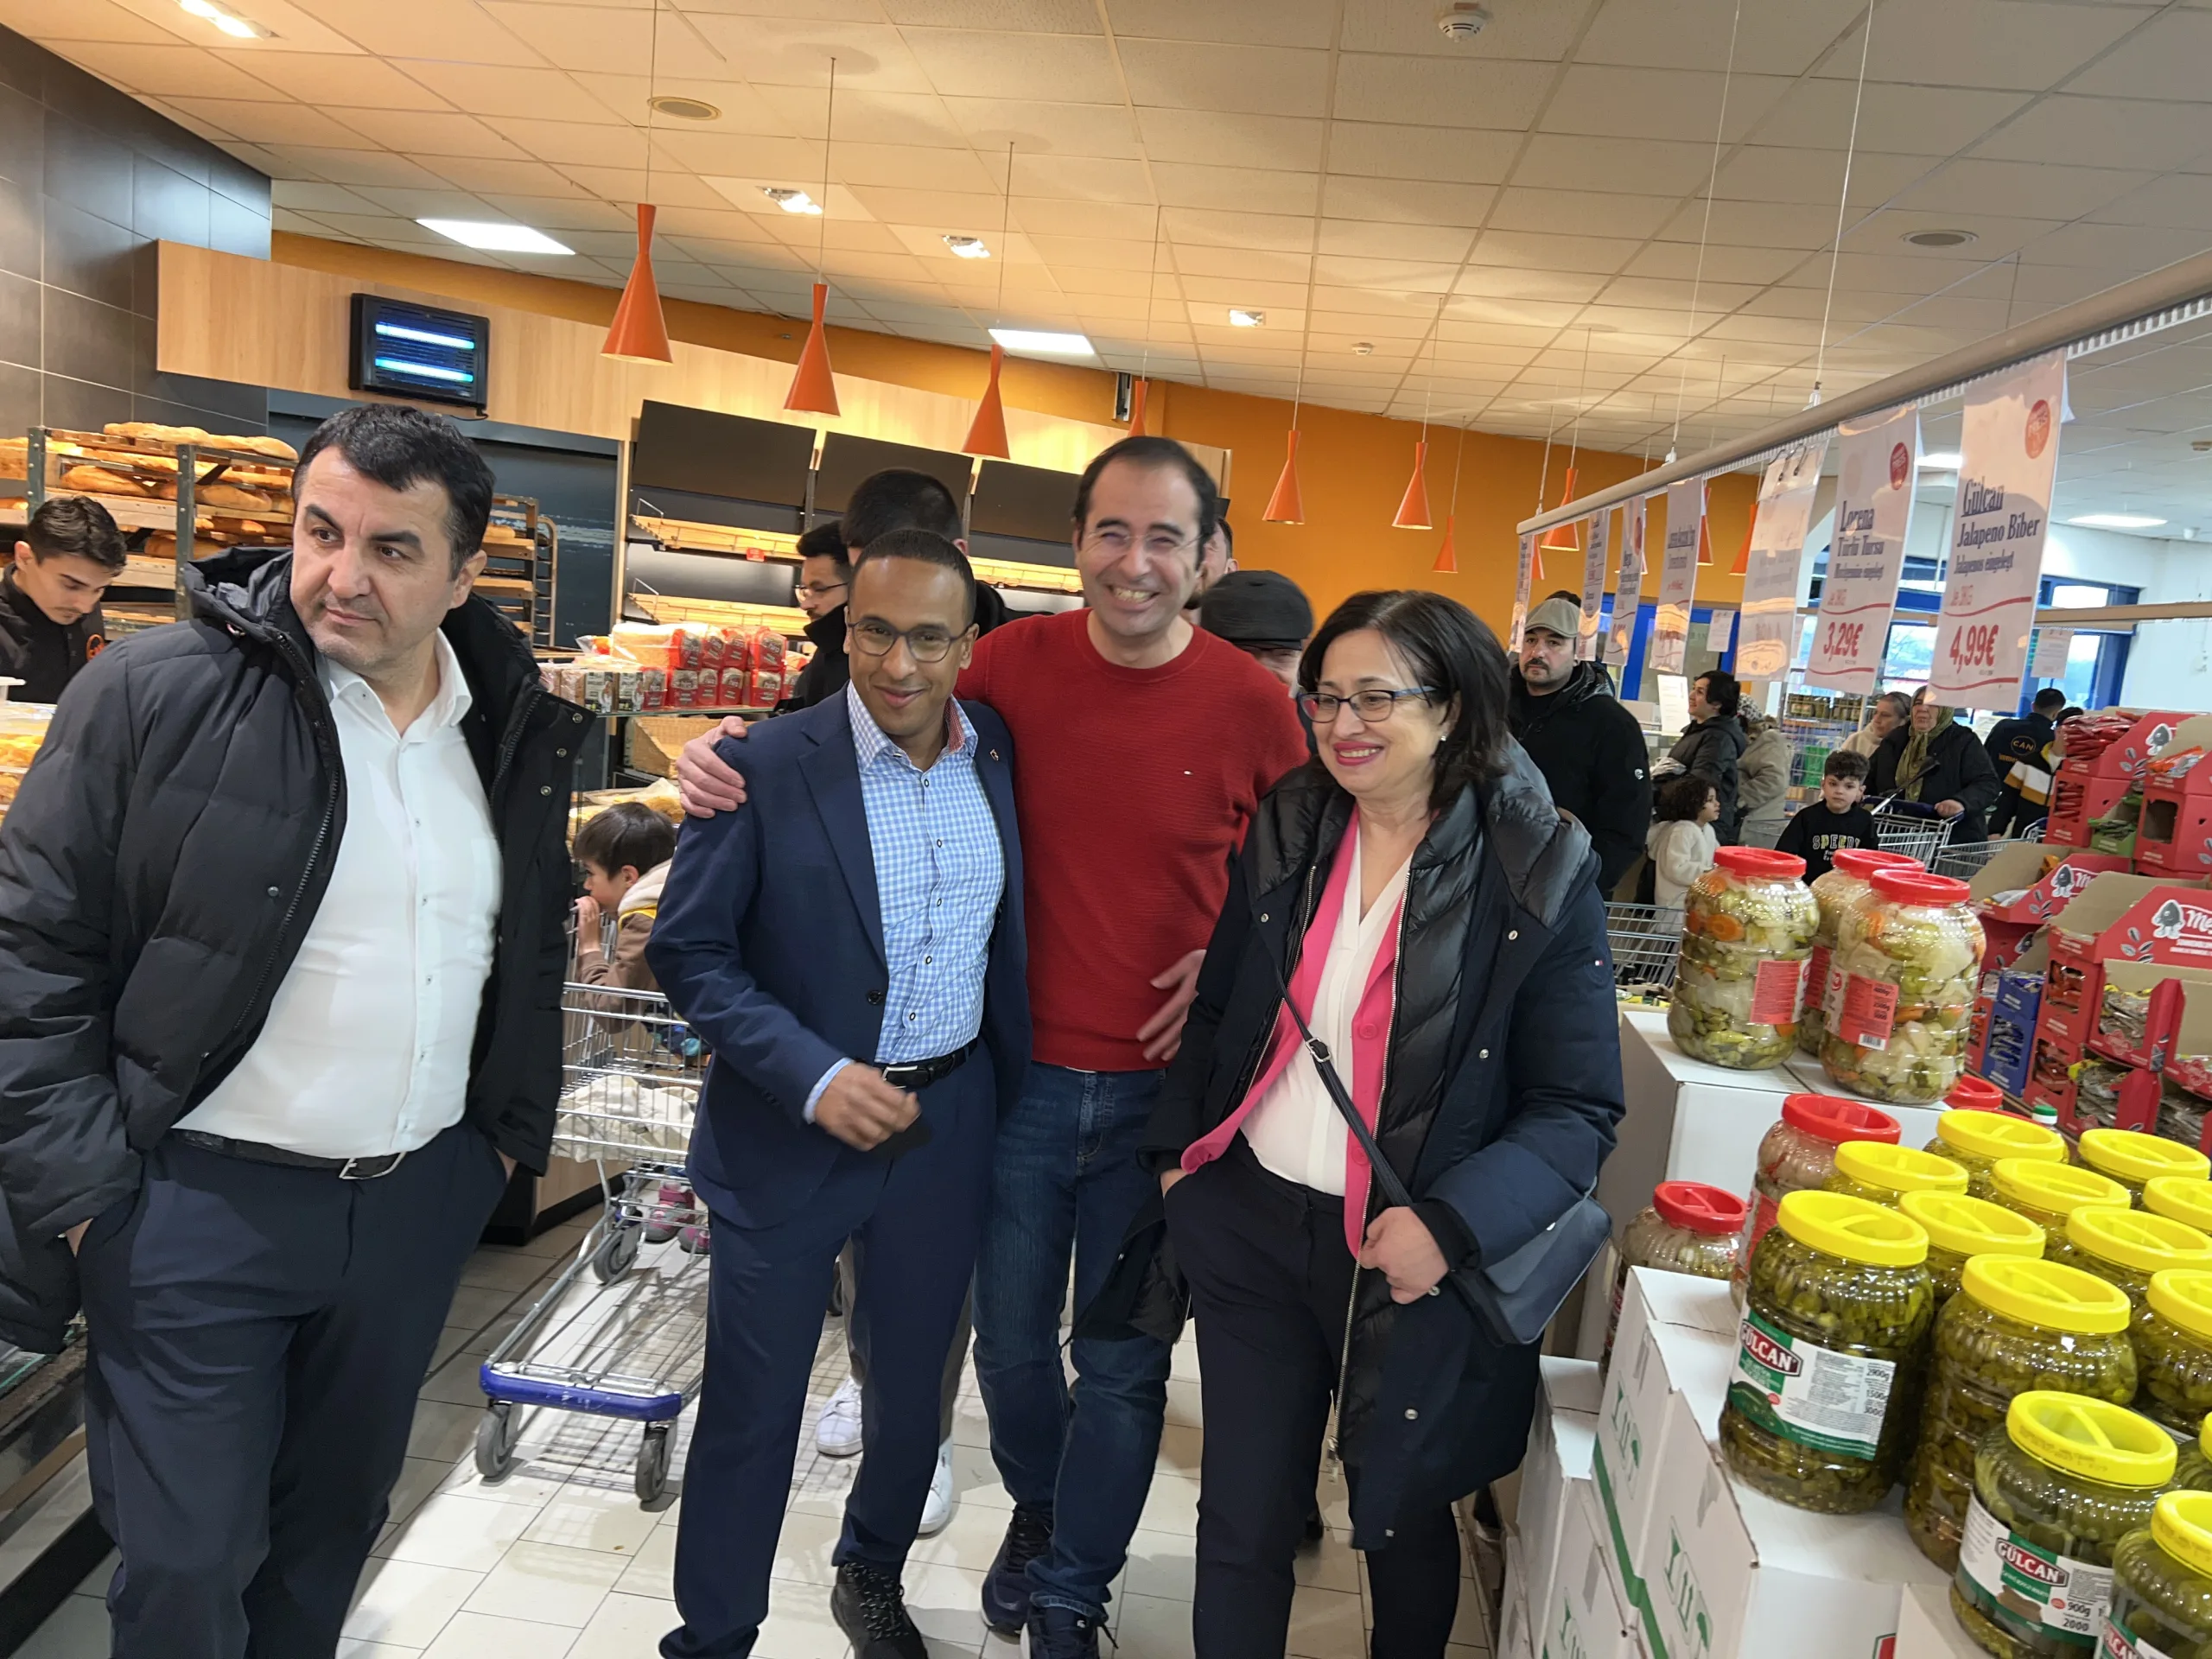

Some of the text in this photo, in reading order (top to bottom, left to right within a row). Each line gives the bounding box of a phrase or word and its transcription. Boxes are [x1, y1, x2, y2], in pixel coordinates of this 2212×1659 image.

[1840, 500, 1875, 532] Lorena
[1962, 476, 2005, 517] Gülcan
[1957, 512, 2040, 549] Jalapeno Biber
[1823, 621, 1864, 663] 3,29€
[1949, 624, 1999, 674] 4,99€
[2012, 741, 2034, 752] CAN
[1740, 1324, 1793, 1372] GÜLCAN
[1998, 1542, 2059, 1583] GÜLCAN
[2063, 1618, 2089, 1632] 2000
[2068, 1601, 2091, 1618] 900g
